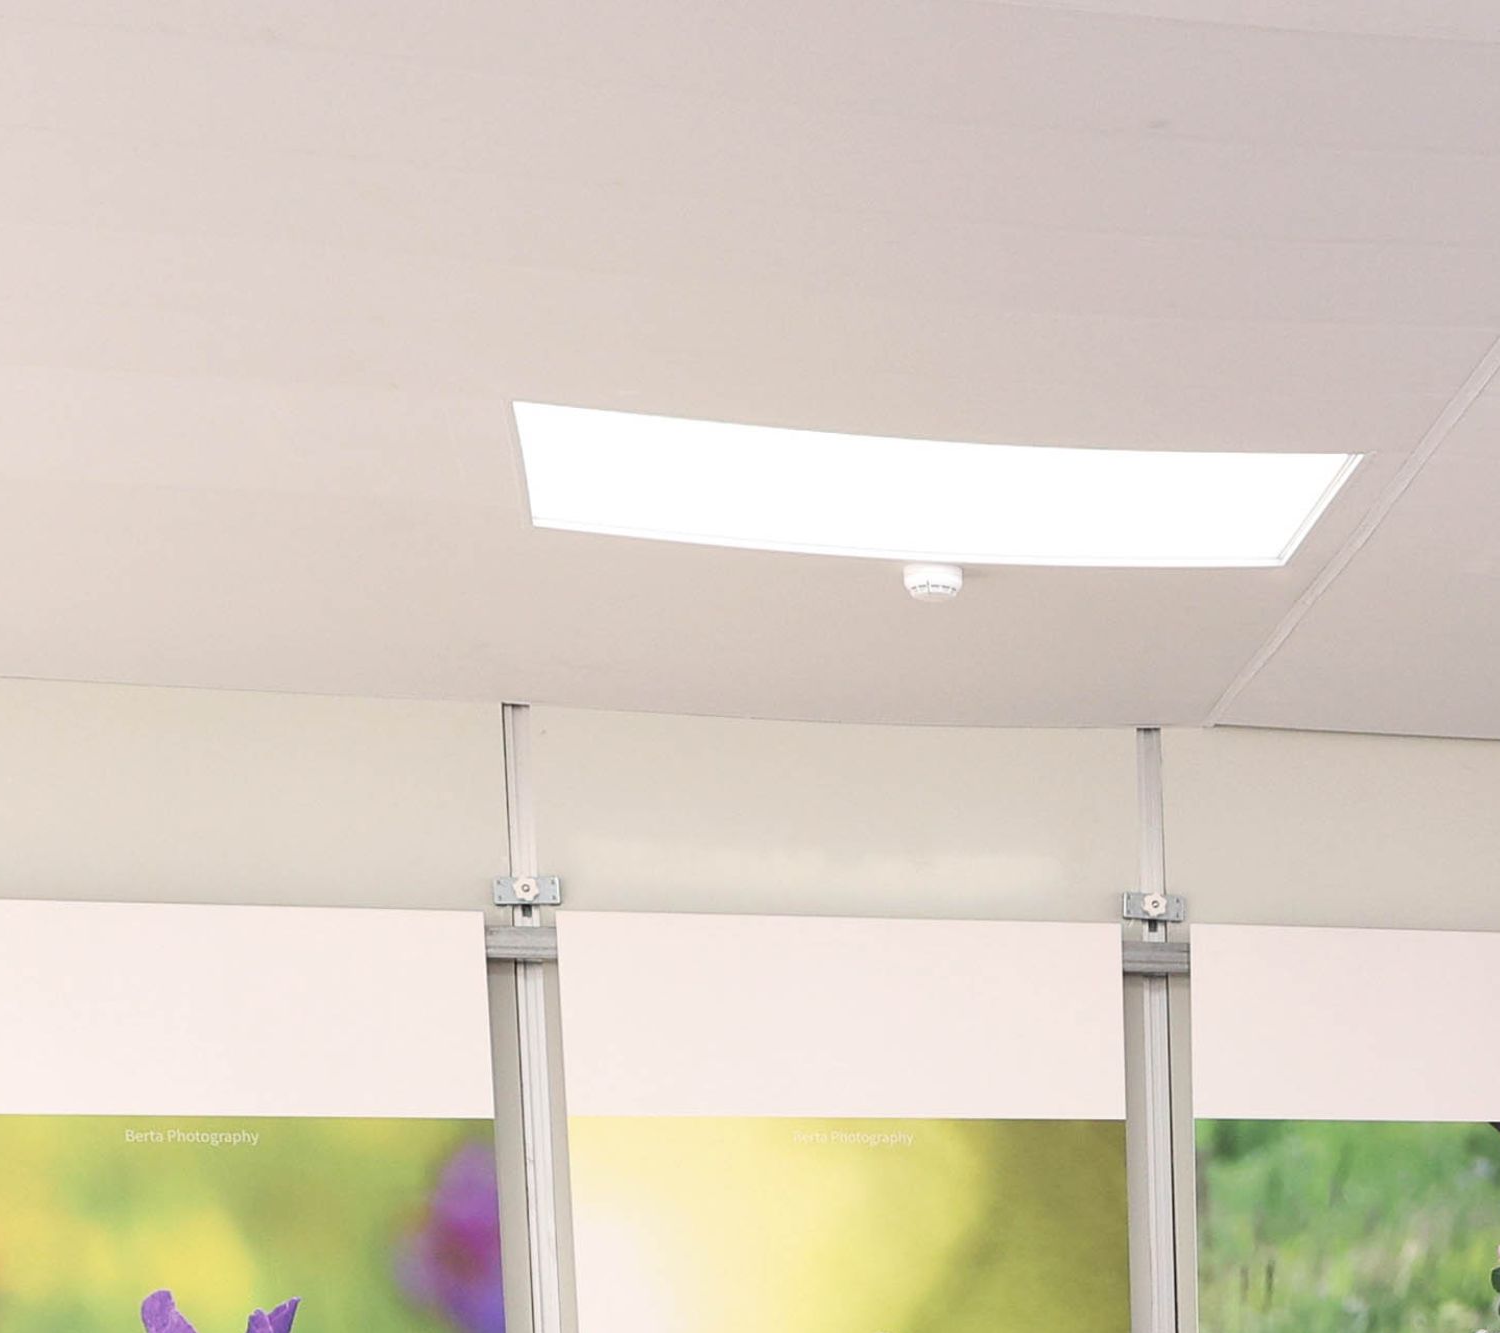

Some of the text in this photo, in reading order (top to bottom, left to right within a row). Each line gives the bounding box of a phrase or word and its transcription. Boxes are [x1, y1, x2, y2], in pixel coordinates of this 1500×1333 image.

[125, 1129, 259, 1146] Berta Photography
[832, 1131, 914, 1147] Photography
